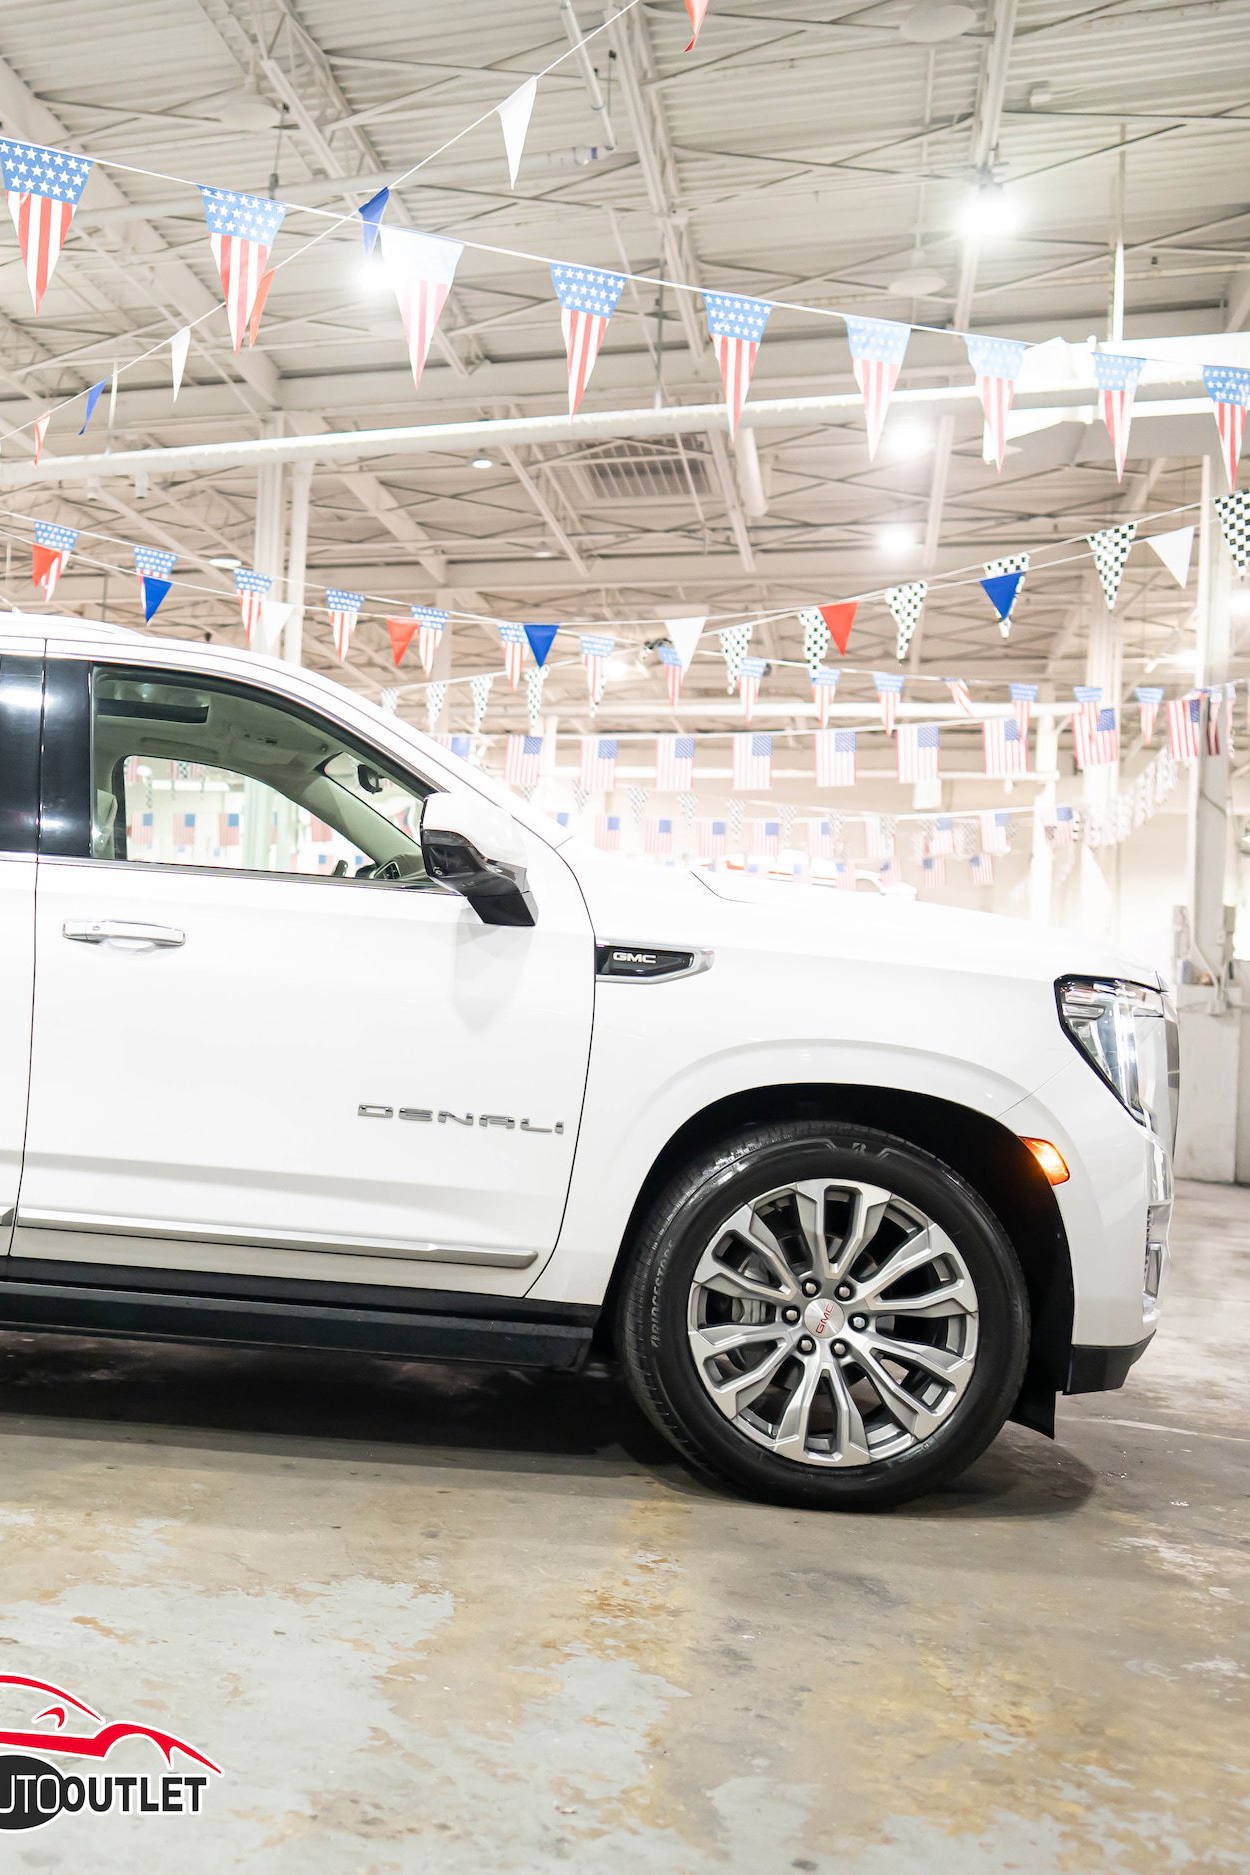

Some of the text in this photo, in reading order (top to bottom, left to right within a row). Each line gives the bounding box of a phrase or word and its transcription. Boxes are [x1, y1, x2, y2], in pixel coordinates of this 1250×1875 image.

[612, 951, 657, 964] GMC
[357, 1104, 564, 1135] DENALI
[815, 1302, 835, 1334] GMC
